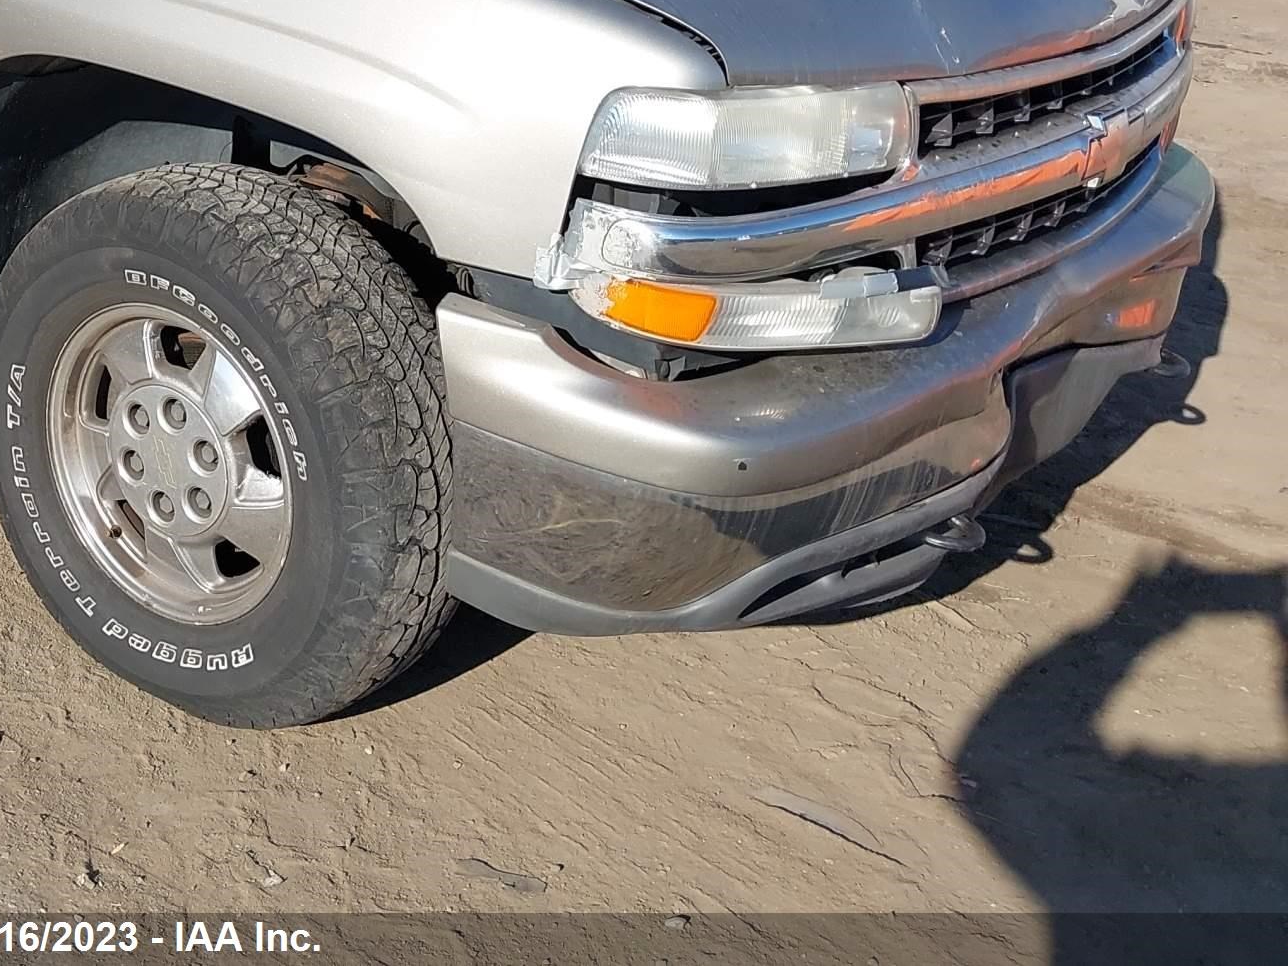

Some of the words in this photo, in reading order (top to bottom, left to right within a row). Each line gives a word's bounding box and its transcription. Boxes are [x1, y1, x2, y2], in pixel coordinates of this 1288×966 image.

[6, 363, 27, 431] T/A
[123, 268, 308, 482] BFGoodrich
[11, 445, 97, 618] Terrain
[102, 617, 255, 672] Rugged
